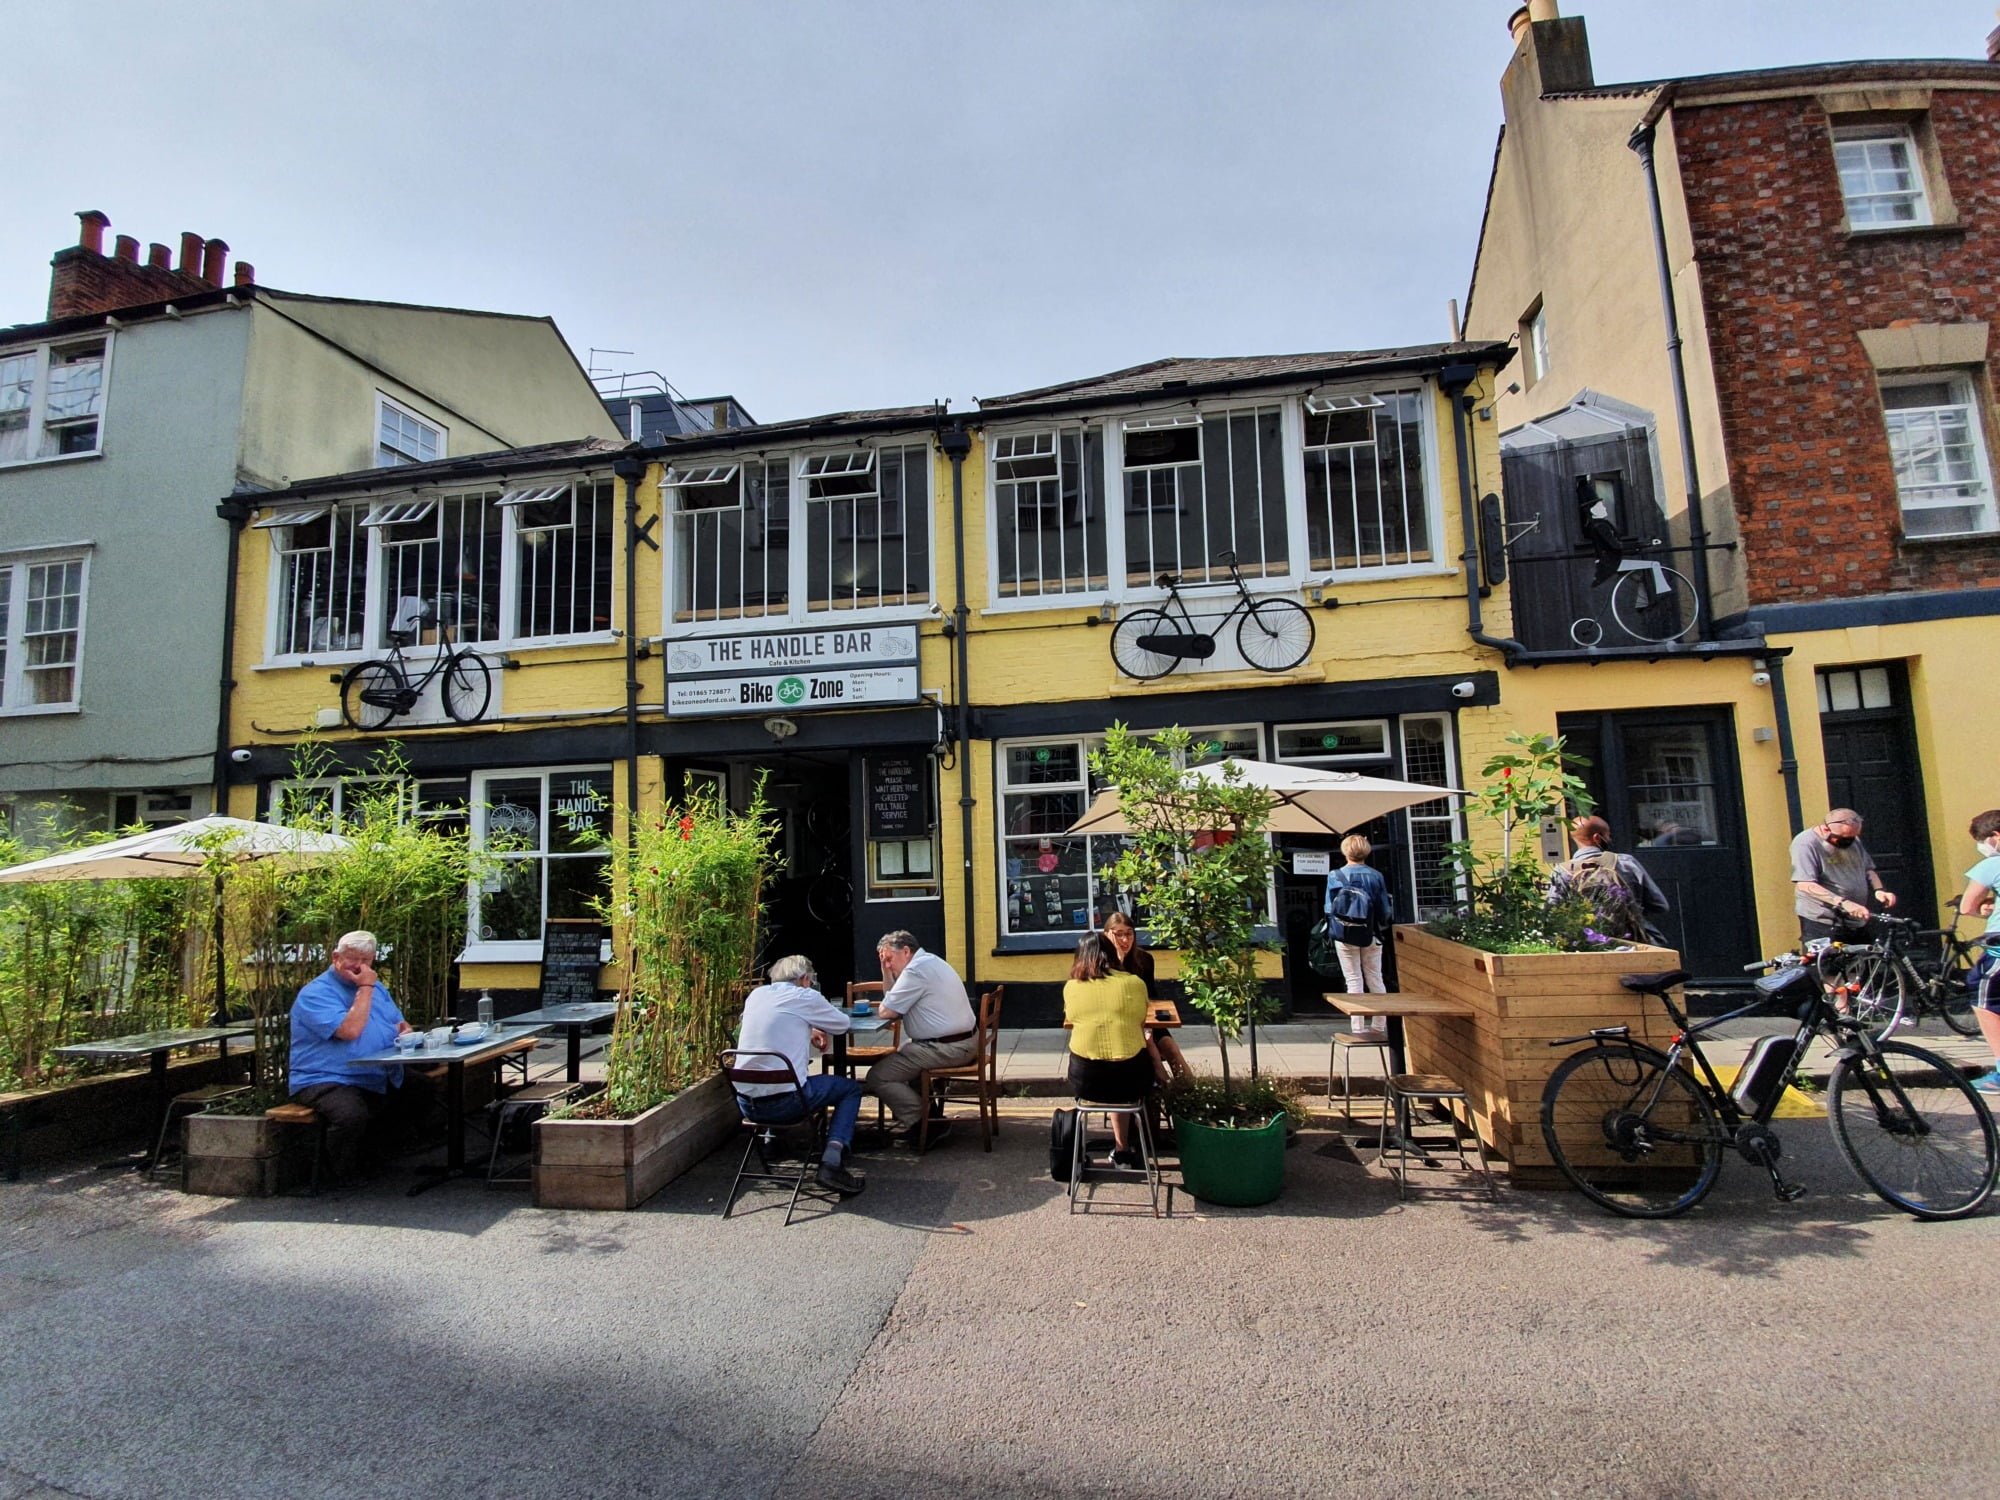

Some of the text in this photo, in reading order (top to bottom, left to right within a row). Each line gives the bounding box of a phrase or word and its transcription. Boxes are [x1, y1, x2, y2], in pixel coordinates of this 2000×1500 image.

[708, 631, 872, 662] THE HANDLE BAR
[740, 678, 844, 704] Bike Zone
[672, 696, 736, 706] bikezoneoxford.co.uk
[1223, 740, 1245, 752] Zone
[1339, 735, 1361, 746] Zone
[570, 779, 593, 795] THE
[875, 785, 889, 793] WAIT
[889, 785, 904, 793] HERE
[881, 794, 909, 802] GREETED
[874, 802, 906, 811] FULL TABLE
[881, 811, 908, 820] SERVICE
[568, 815, 593, 832] BAR
[1778, 1024, 1815, 1088] carrera
